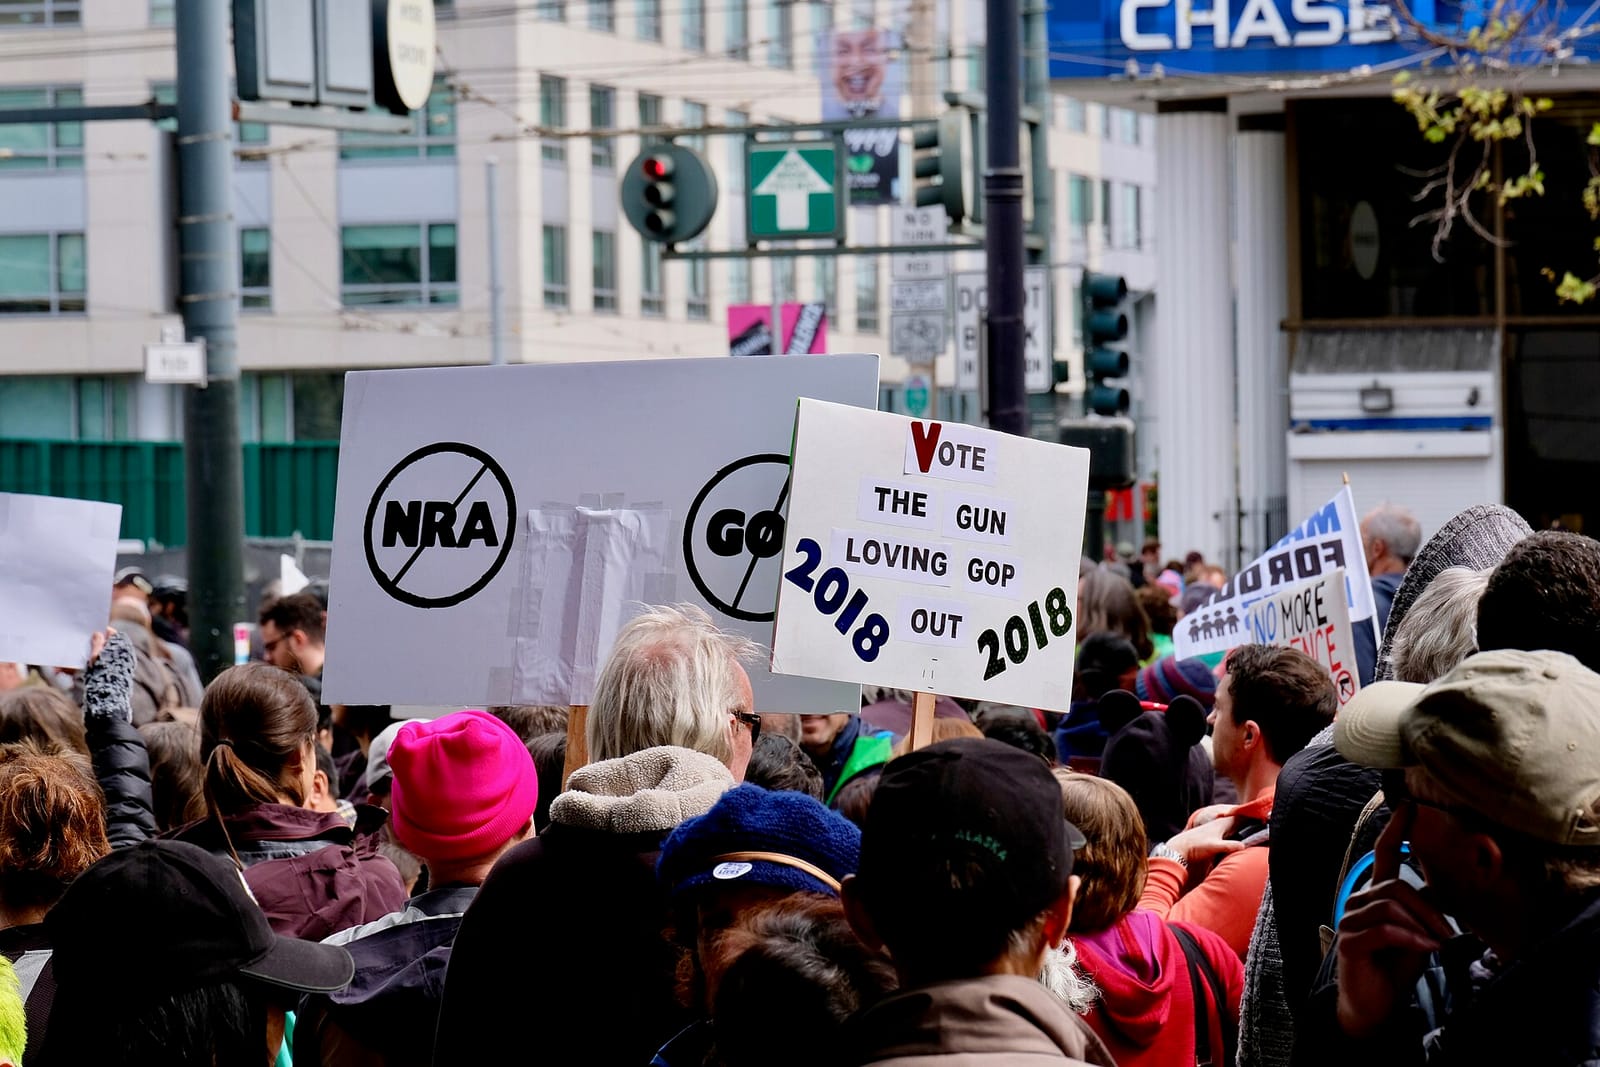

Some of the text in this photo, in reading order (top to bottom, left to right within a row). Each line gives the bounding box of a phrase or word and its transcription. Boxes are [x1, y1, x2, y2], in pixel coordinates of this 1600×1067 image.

[1119, 0, 1394, 50] CHASE
[904, 213, 931, 227] NO
[911, 421, 986, 473] VOTE
[382, 501, 499, 548] NRA
[706, 508, 784, 558] GO
[874, 486, 1006, 535] THE GUN
[846, 538, 1015, 587] LOVING GOP
[784, 537, 890, 663] 2018
[910, 608, 963, 639] OUT
[1254, 600, 1277, 647] NO
[1280, 580, 1328, 639] MORE
[977, 587, 1073, 681] 2018
